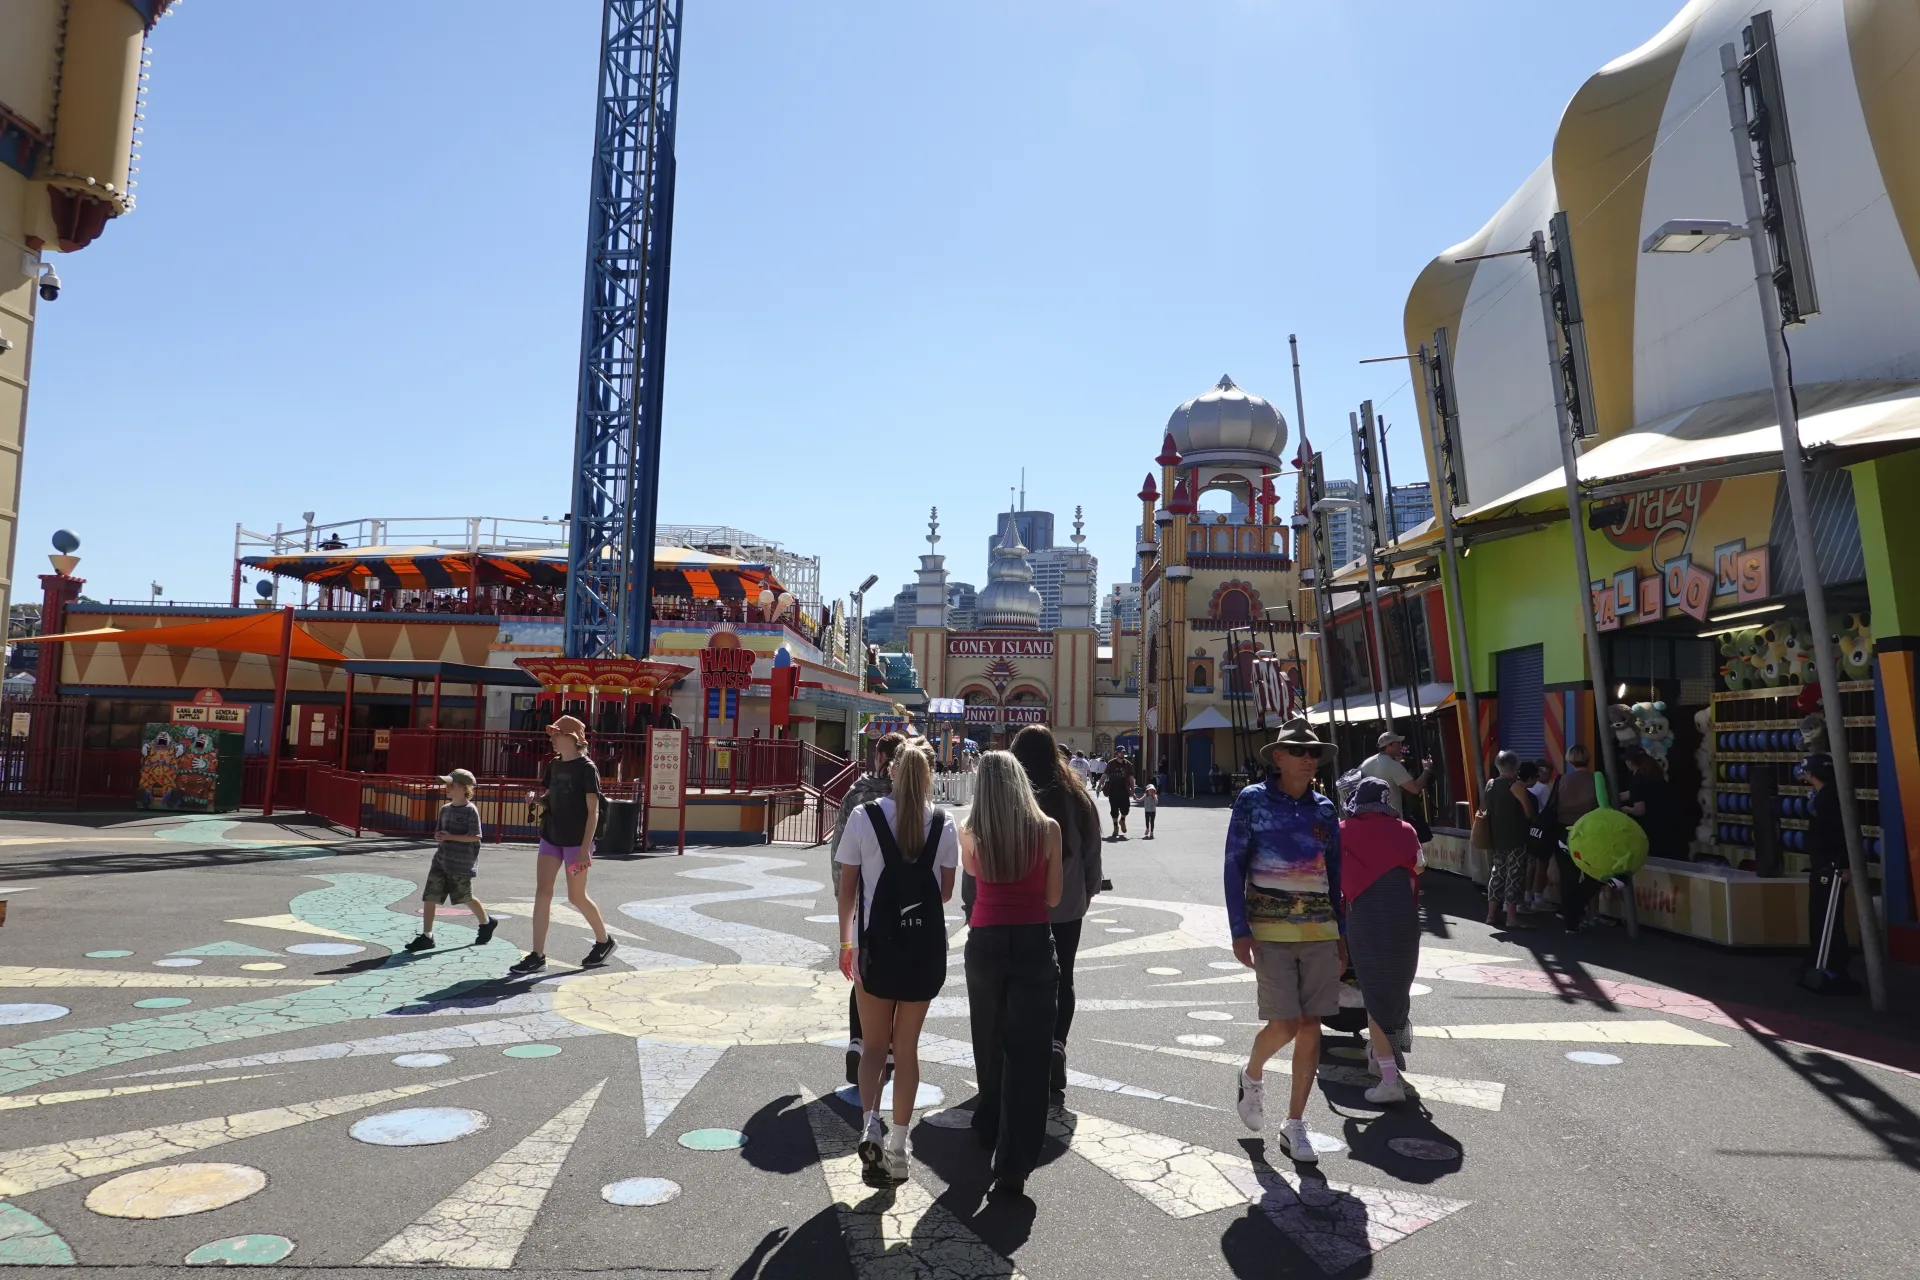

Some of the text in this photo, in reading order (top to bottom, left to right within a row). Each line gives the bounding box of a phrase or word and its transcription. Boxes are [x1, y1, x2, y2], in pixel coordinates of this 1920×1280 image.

[949, 640, 1054, 654] CONEY ISLAND
[698, 647, 757, 674] HAIR
[700, 672, 753, 690] RAISER
[1009, 710, 1041, 722] LAND
[376, 736, 389, 744] 136
[900, 918, 922, 928] AIR
